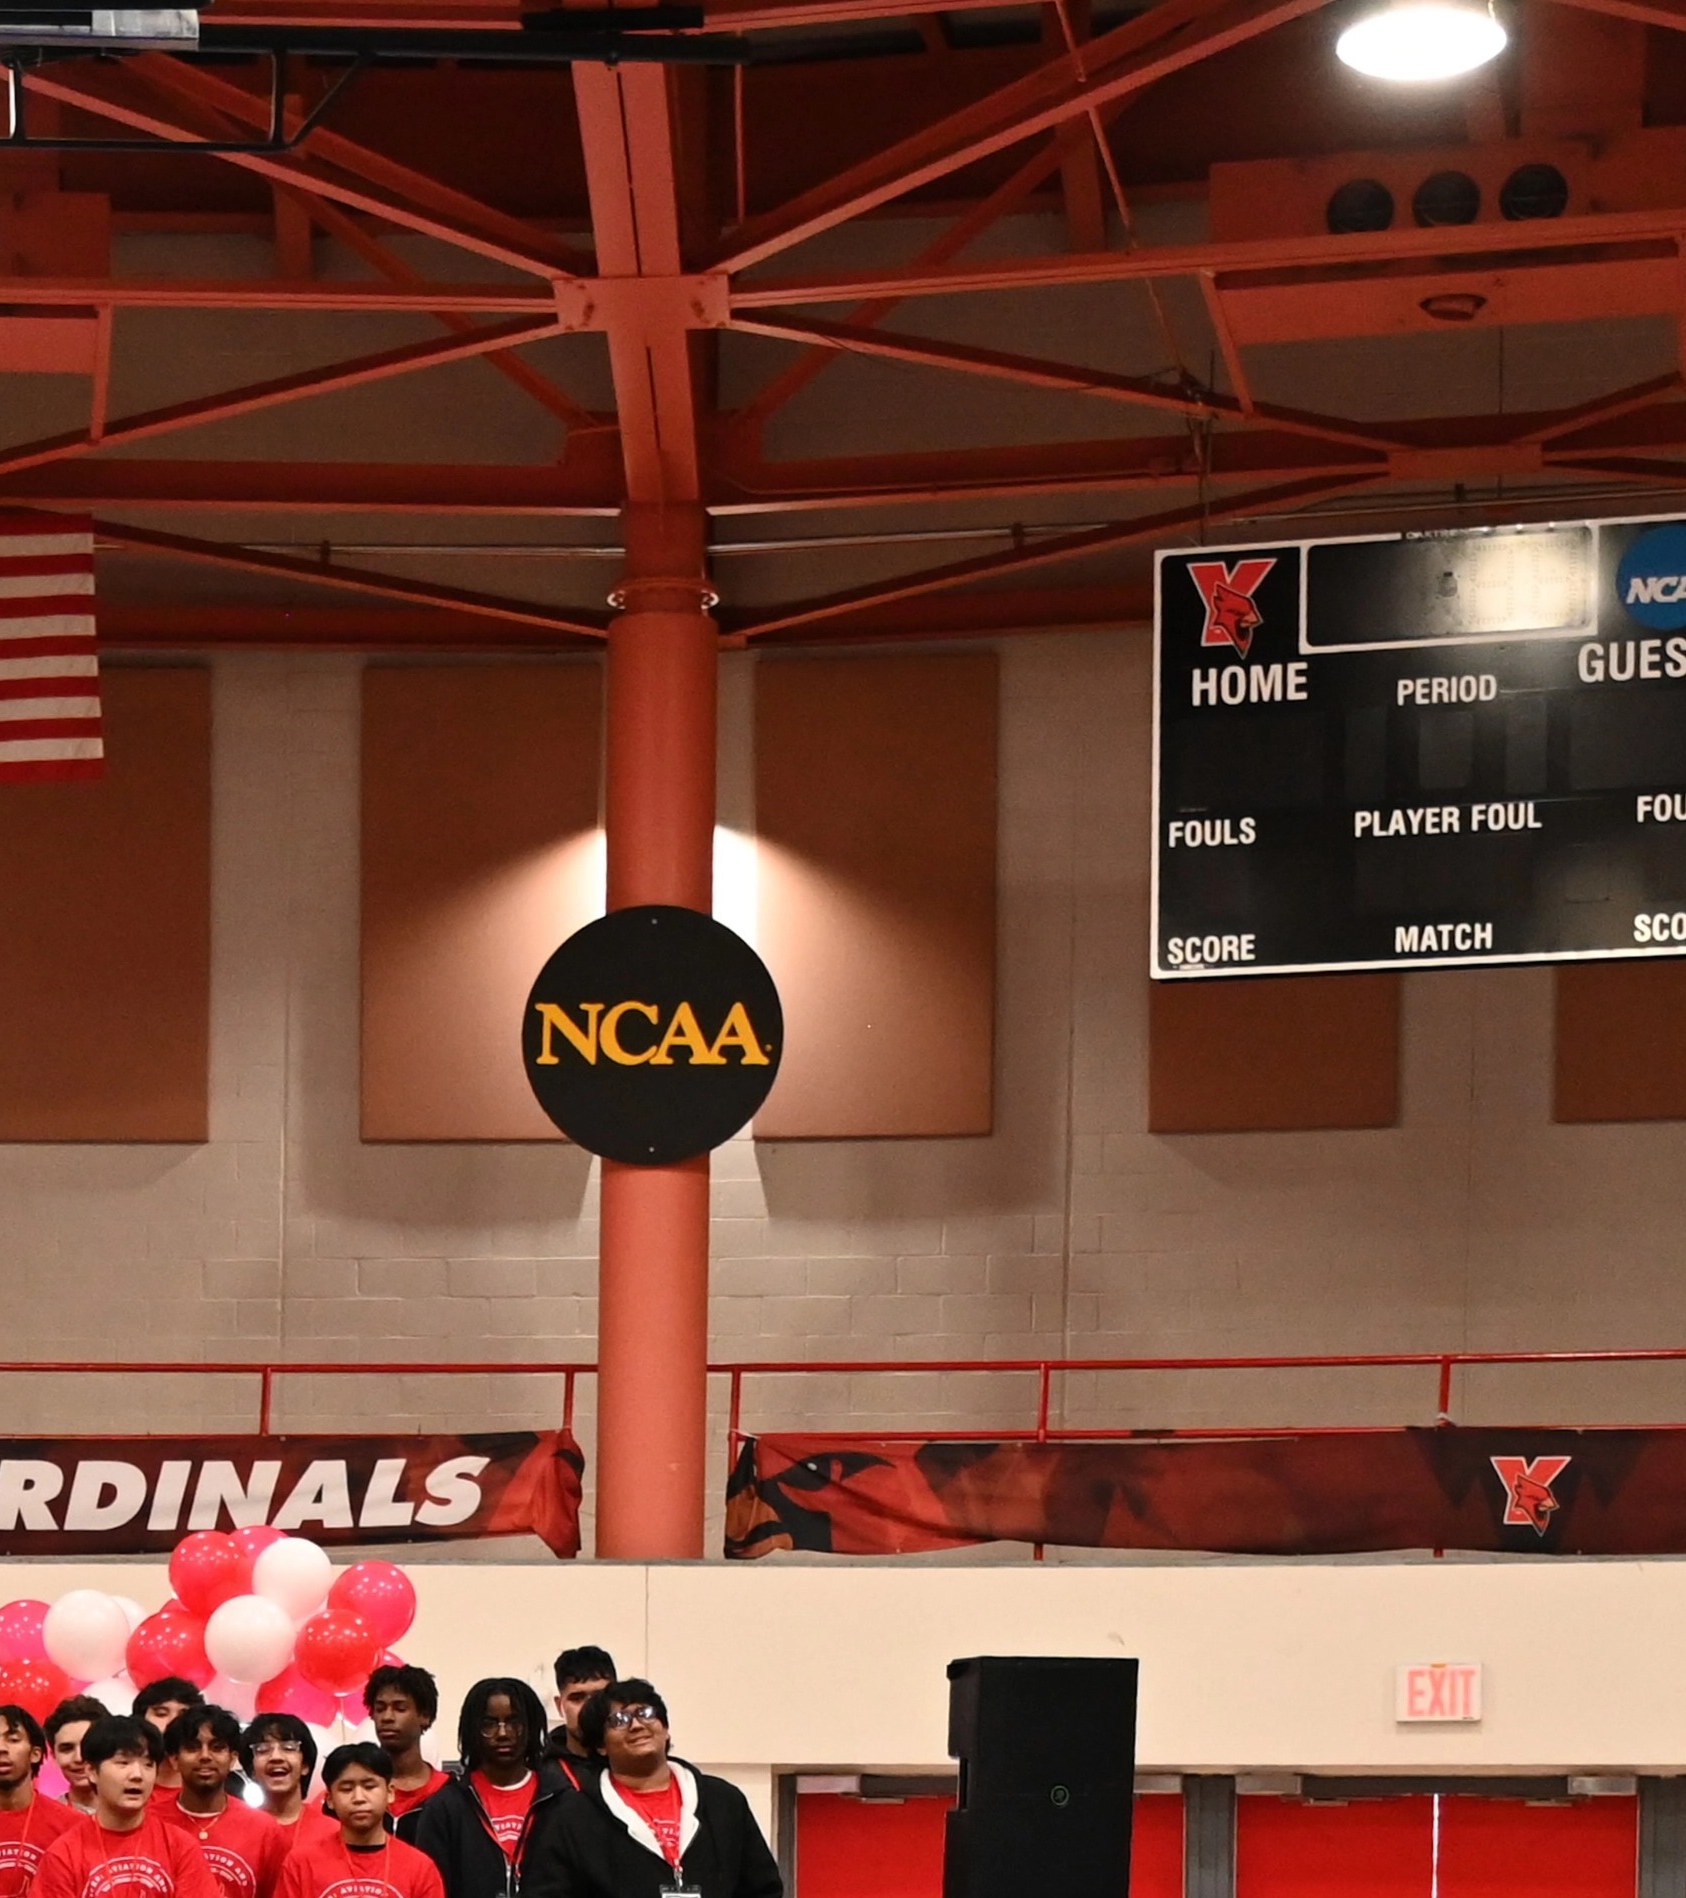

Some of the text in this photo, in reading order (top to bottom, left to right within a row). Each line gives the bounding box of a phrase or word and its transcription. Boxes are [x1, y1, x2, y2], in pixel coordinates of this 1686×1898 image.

[1191, 661, 1309, 706] HOME
[1396, 674, 1498, 706] PERIOD
[1168, 818, 1257, 848] FOULS
[1354, 801, 1543, 839] PLAYER FOUL
[1167, 935, 1256, 966] SCORE
[1394, 923, 1493, 953] MATCH
[534, 1000, 770, 1066] NCAA
[1406, 1668, 1476, 1717] EXIT
